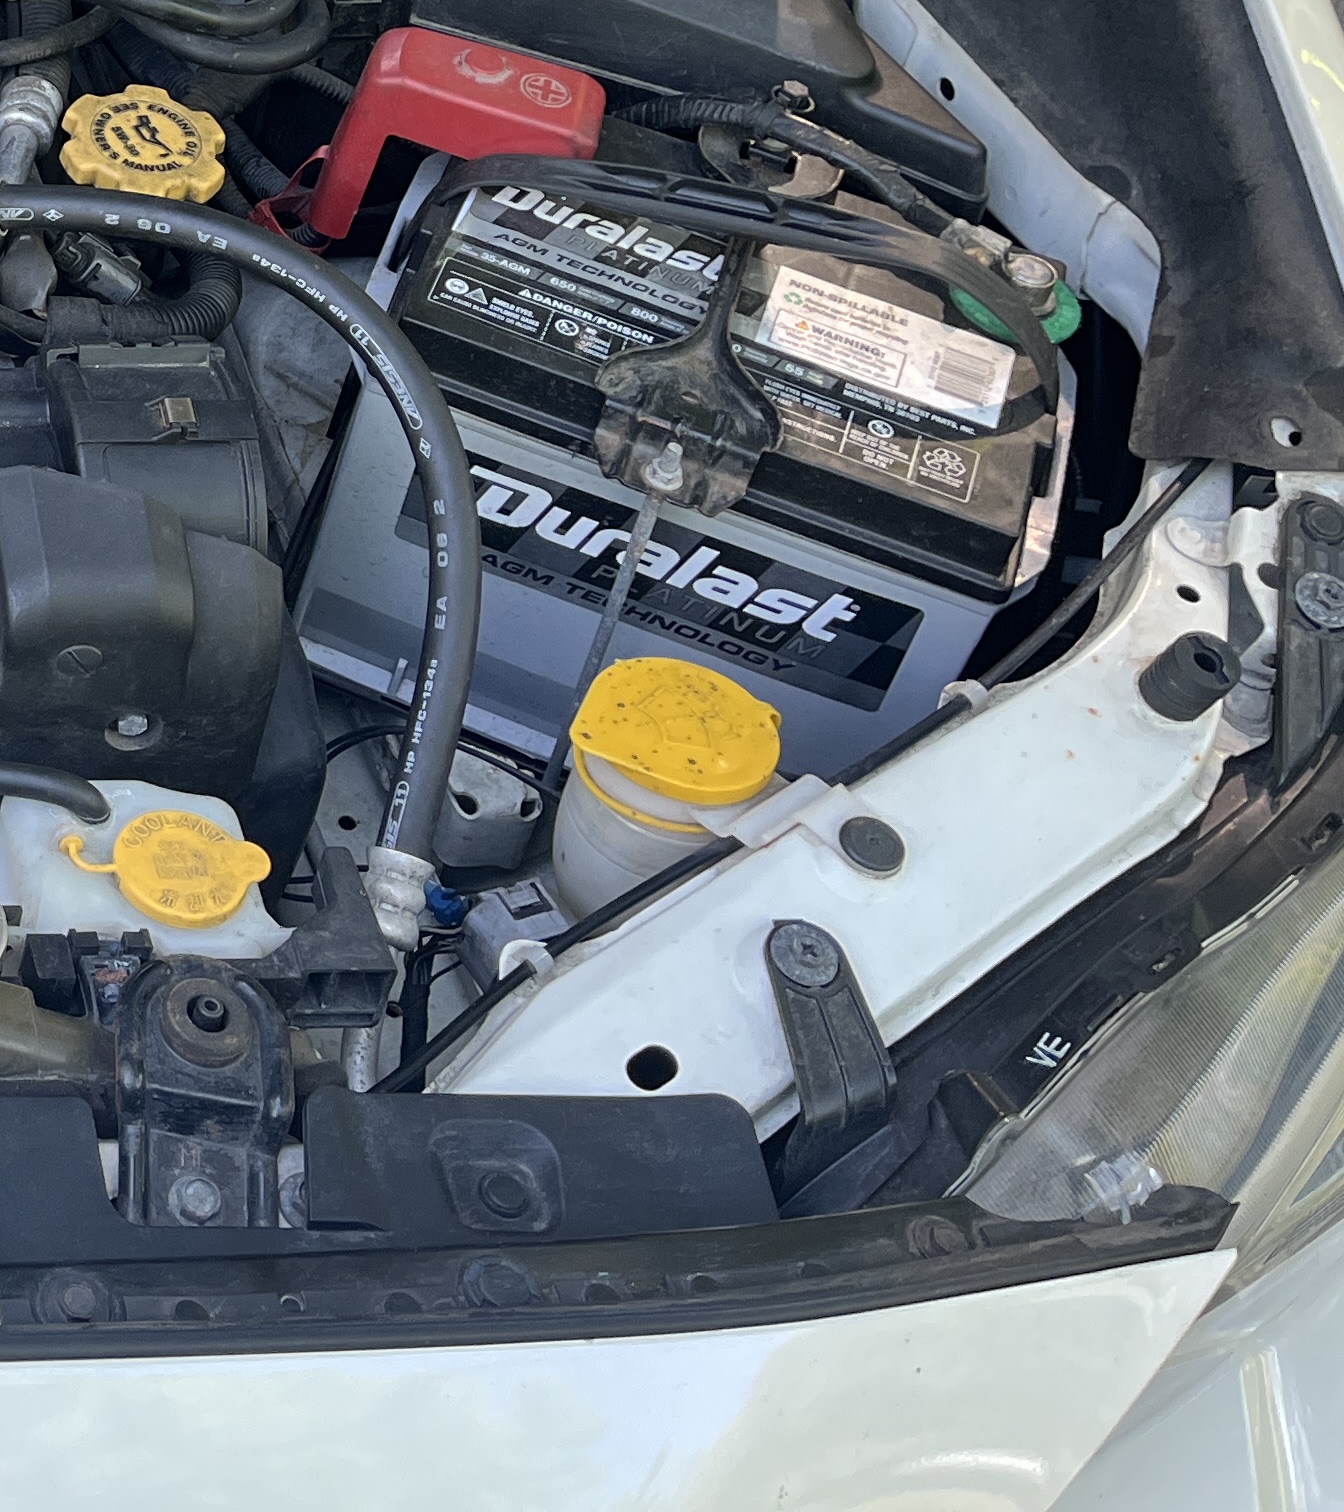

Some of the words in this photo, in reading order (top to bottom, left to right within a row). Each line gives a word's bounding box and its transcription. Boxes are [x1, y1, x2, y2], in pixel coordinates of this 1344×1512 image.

[110, 102, 139, 114] SEE
[147, 104, 197, 138] ENGINE
[180, 141, 198, 159] OIL
[121, 158, 183, 172] MANUAL
[197, 231, 228, 250] EA
[480, 251, 531, 276] 35-AGM
[494, 233, 548, 256] AGM
[557, 254, 710, 315] TECHNOLOGY
[567, 234, 716, 295] PLATINUM
[549, 276, 576, 292] 650
[328, 303, 348, 322] HP
[531, 292, 654, 343] DANGER/POISON
[630, 307, 658, 323] 800
[789, 279, 909, 326] NON-SPILLABLE
[811, 324, 885, 359] WARNING:
[470, 464, 856, 643] Duralast
[481, 554, 555, 585] AGM
[591, 563, 828, 660] PATINUM
[404, 751, 415, 774] HP
[434, 595, 448, 630] EA
[122, 814, 228, 849] COOLANT
[1025, 1032, 1071, 1067] VE
